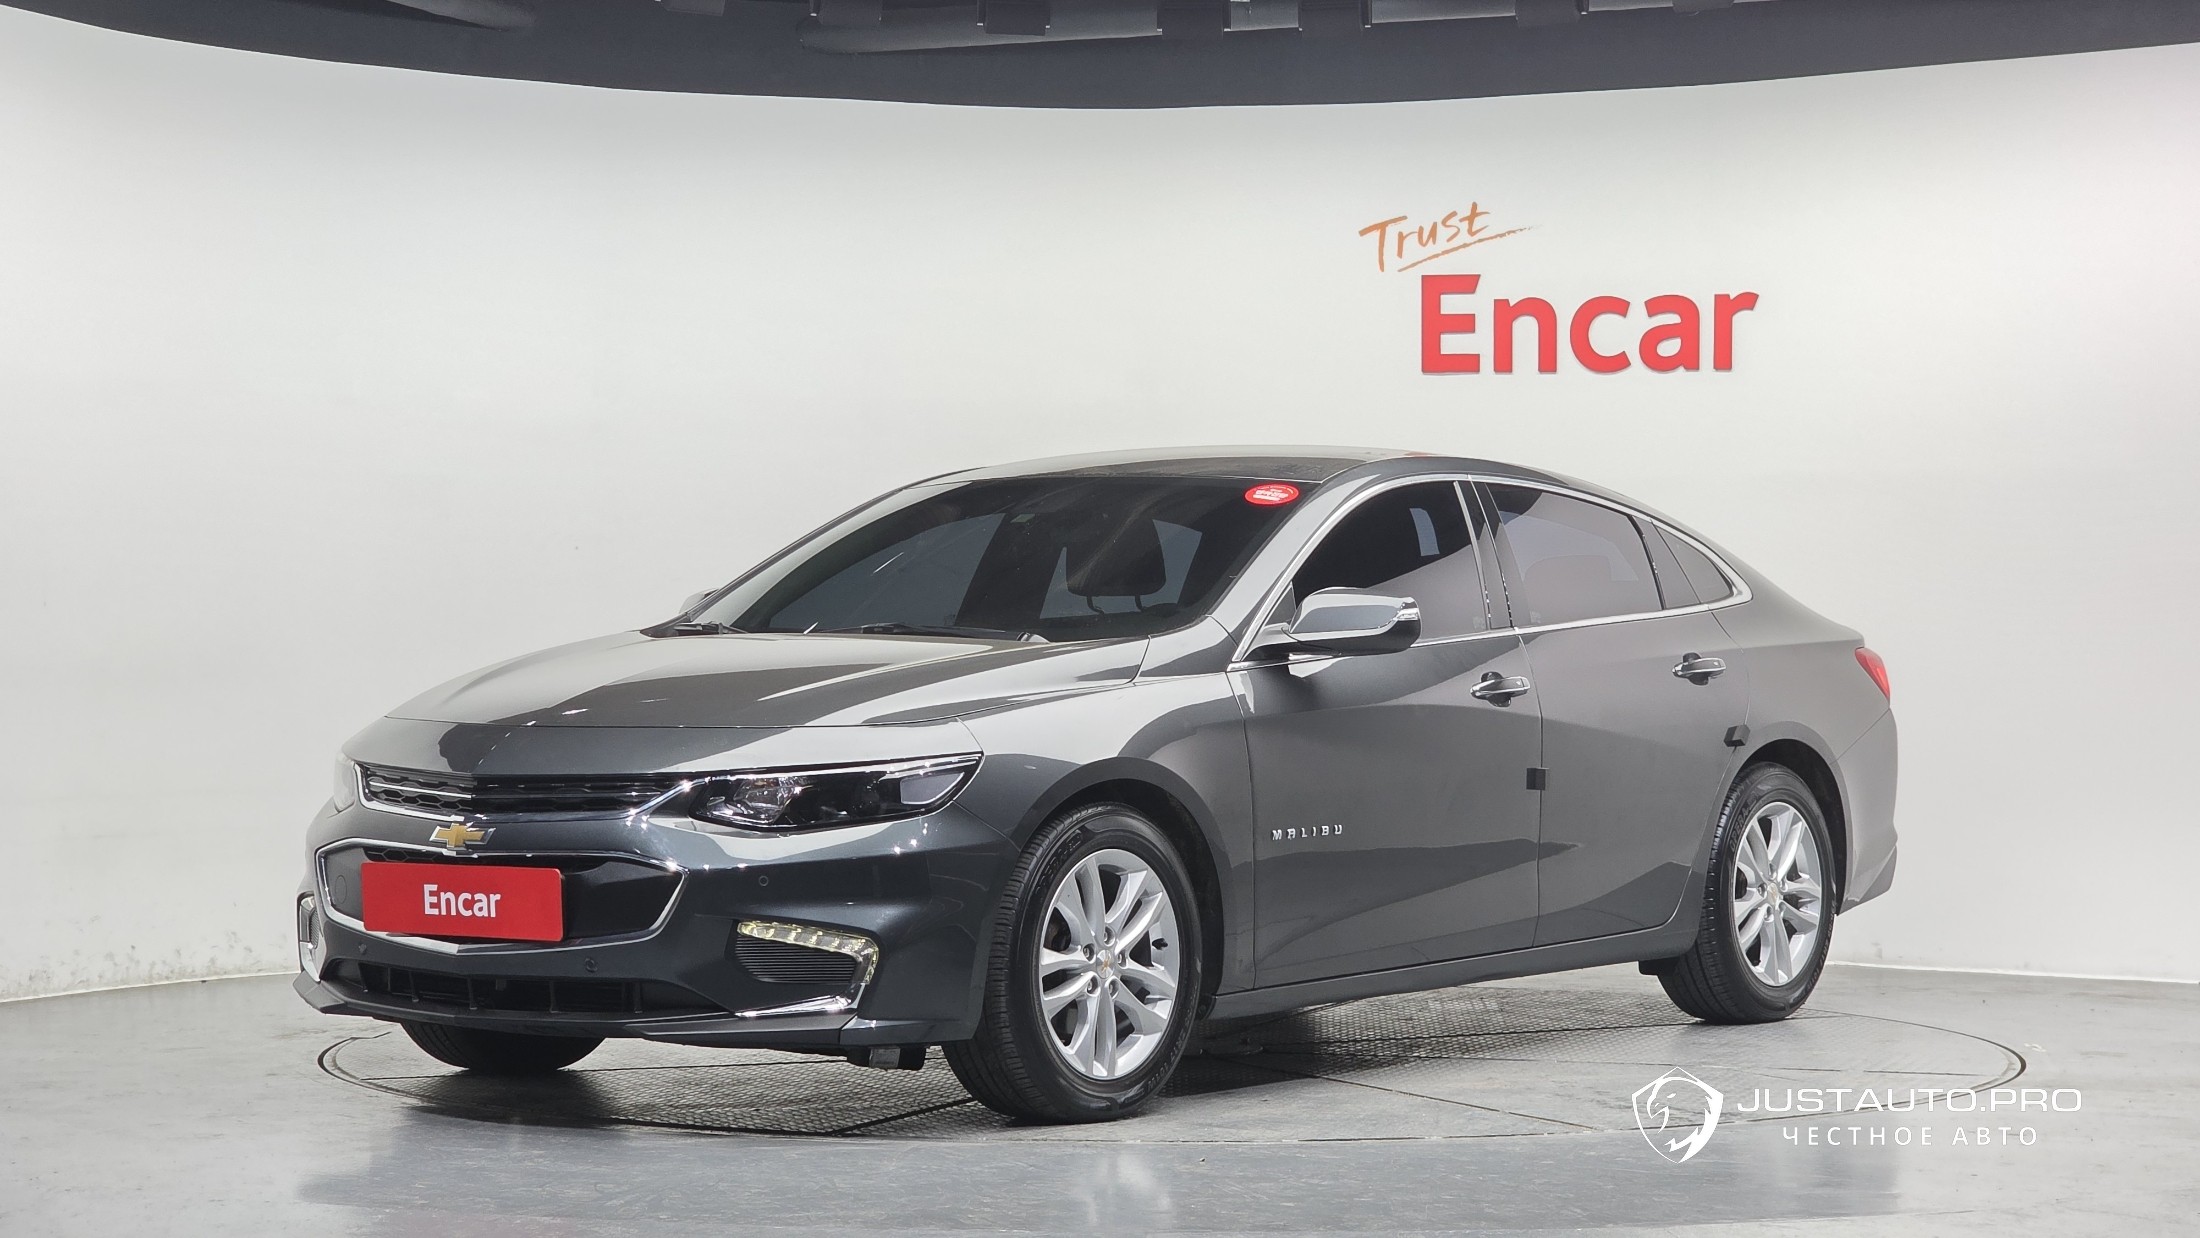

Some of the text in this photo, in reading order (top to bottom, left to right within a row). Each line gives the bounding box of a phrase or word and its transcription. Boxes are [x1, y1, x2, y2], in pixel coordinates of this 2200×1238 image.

[1358, 202, 1491, 272] Trust
[1421, 274, 1759, 374] Encar
[1272, 824, 1343, 841] MALIBU
[423, 884, 501, 918] Encar
